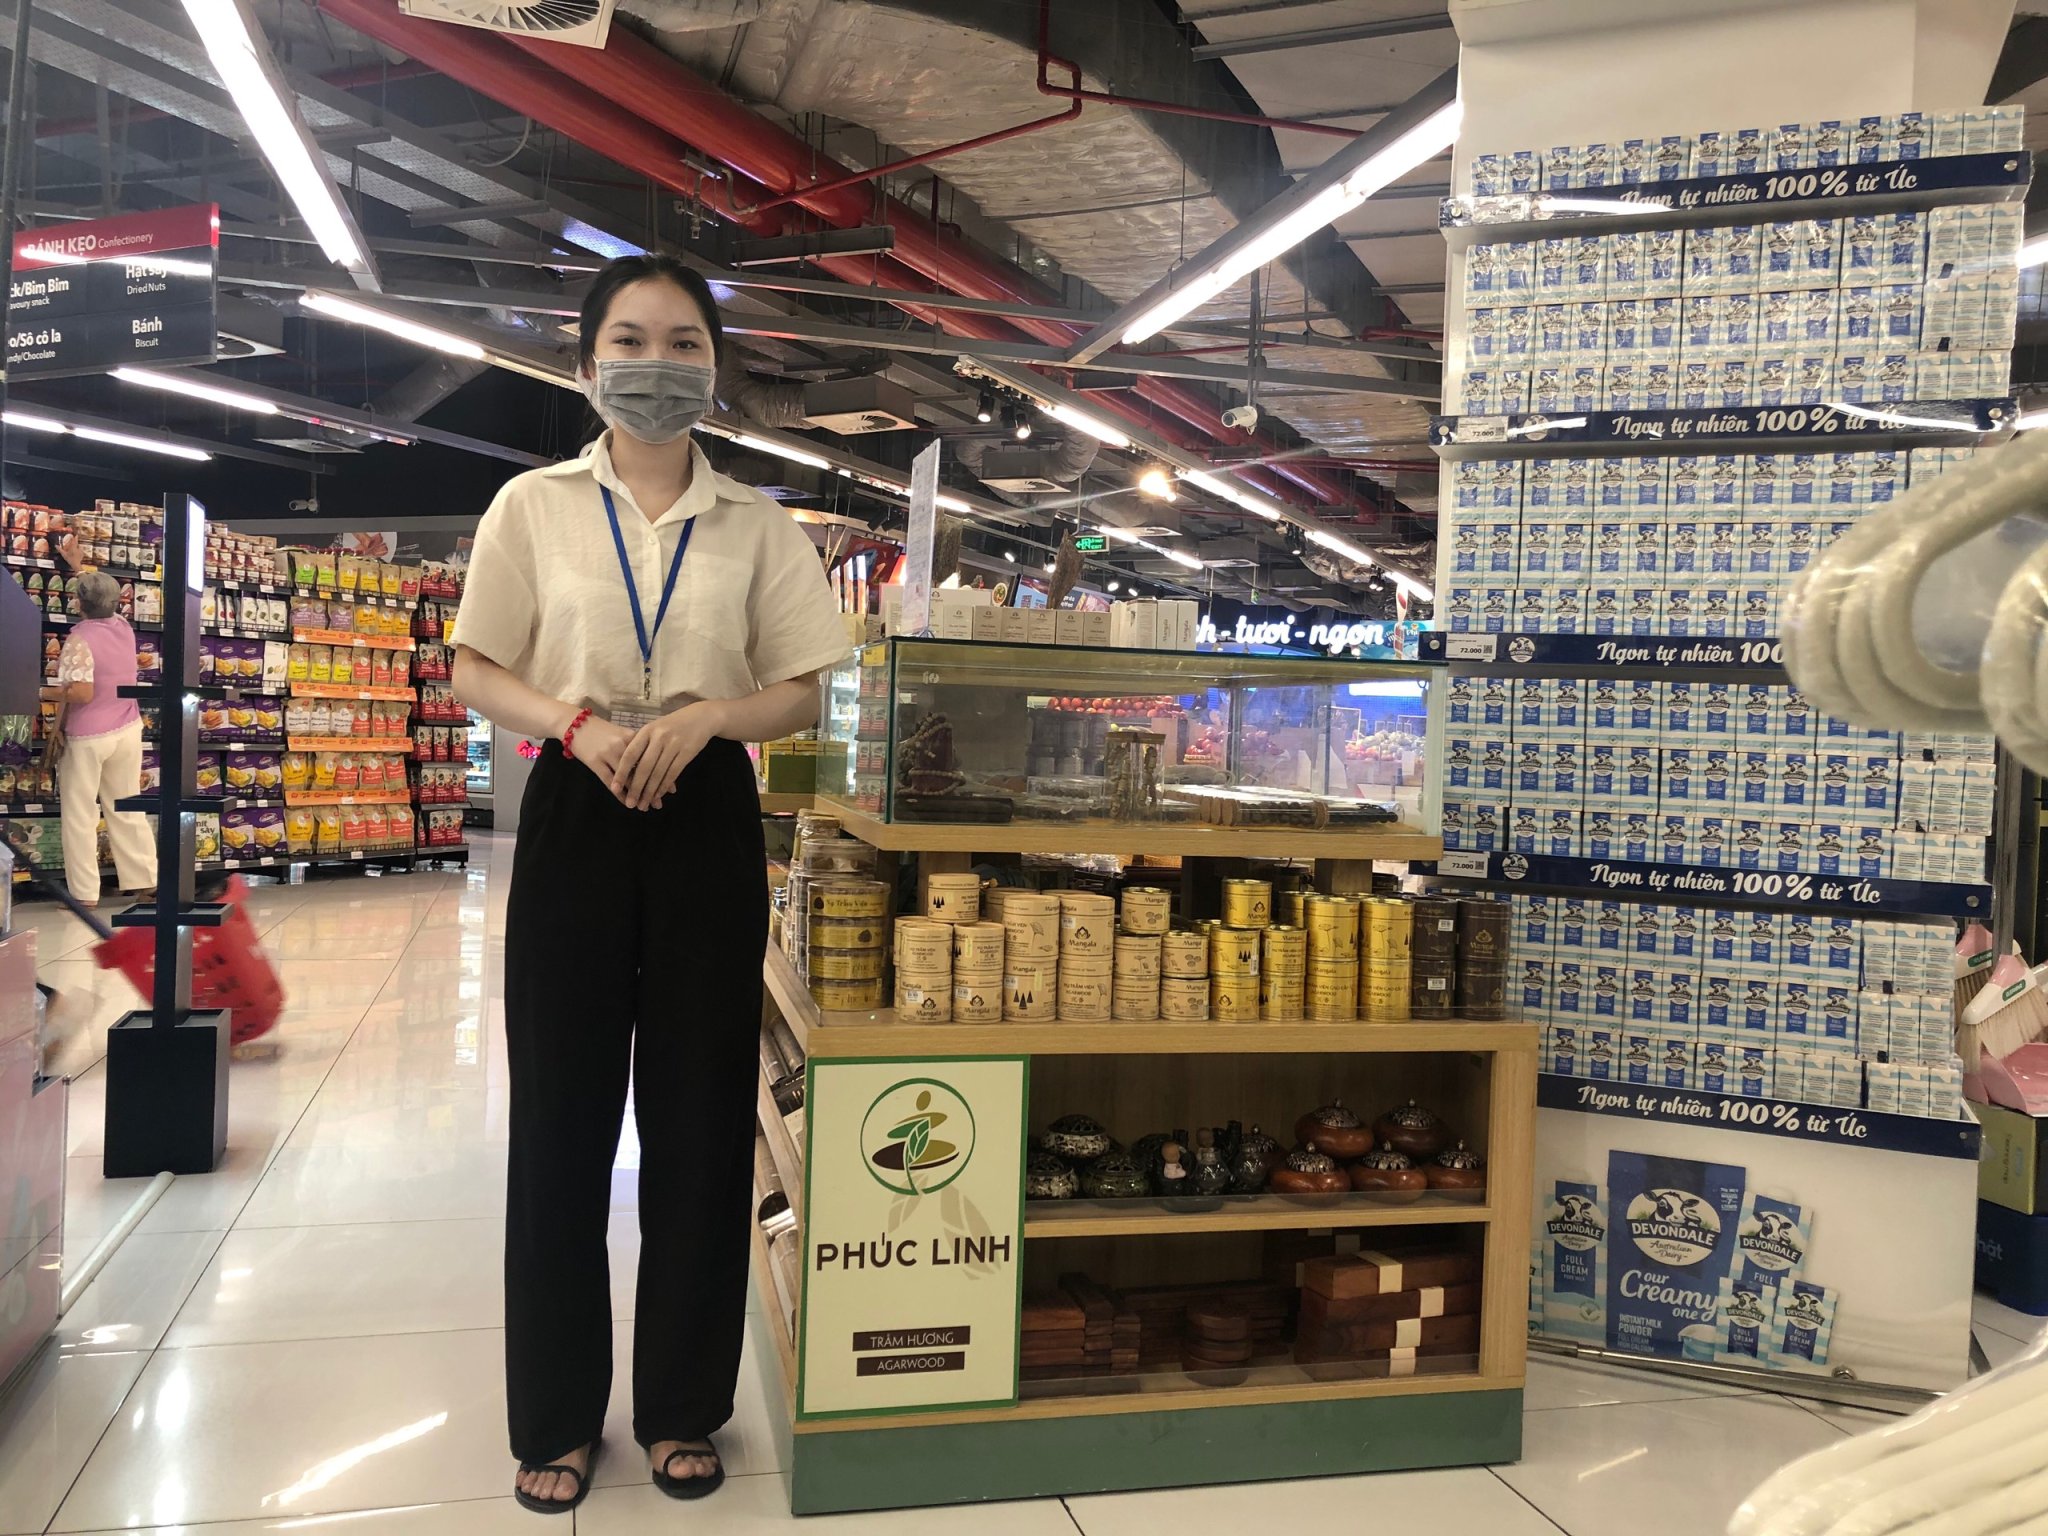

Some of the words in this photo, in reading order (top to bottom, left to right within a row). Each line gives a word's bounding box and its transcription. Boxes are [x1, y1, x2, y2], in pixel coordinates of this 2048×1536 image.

[1680, 189, 1701, 210] tự
[1705, 183, 1759, 205] nhiên
[1766, 170, 1849, 200] 100%
[1856, 174, 1880, 193] từ
[1885, 164, 1918, 190] Úc
[68, 235, 97, 256] KẸO
[98, 233, 153, 249] Confectionery
[48, 277, 69, 293] Bim
[127, 283, 147, 295] Dried
[149, 282, 166, 292] Nuts
[132, 316, 163, 334] Bánh
[36, 330, 49, 345] cô
[51, 328, 61, 343] la
[135, 337, 159, 348] Biscuit
[1611, 415, 1665, 440] Ngon
[1671, 415, 1692, 439] tự
[1697, 413, 1750, 434] nhiên
[1755, 407, 1839, 433] 100%
[1236, 615, 1296, 645] tươi
[1309, 624, 1384, 654] ngon
[1596, 642, 1651, 666] Ngon
[1656, 643, 1677, 667] tự
[1680, 641, 1734, 663] nhiên
[1452, 862, 1474, 870] 72.000
[1590, 863, 1643, 889] Ngon
[1648, 872, 1669, 892] tự
[1673, 871, 1727, 892] nhiên
[1732, 871, 1813, 901] 100%
[1820, 883, 1843, 901] từ
[1848, 877, 1881, 904] Úc
[1577, 1085, 1632, 1111] Ngon
[1635, 1093, 1656, 1117] tự
[1661, 1091, 1714, 1119] nhiên
[1719, 1099, 1800, 1132] 100%
[1806, 1112, 1830, 1134] từ
[1835, 1112, 1868, 1139] Úc
[1549, 1222, 1602, 1239] DEVONDALE
[1631, 1222, 1716, 1247] DEVONDALE
[816, 1232, 918, 1271] PHÚC
[931, 1235, 1011, 1265] LINH
[1649, 1240, 1692, 1253] Australian
[1742, 1237, 1799, 1261] DEVONDALE
[1565, 1254, 1584, 1266] FULL
[1560, 1264, 1589, 1276] CREAM
[1643, 1271, 1670, 1285] our
[1753, 1272, 1774, 1285] FULL
[1619, 1269, 1719, 1322] Creamy
[1672, 1307, 1698, 1320] one
[1728, 1308, 1764, 1322] DEVONDALE
[1786, 1309, 1823, 1323] DEVONDALE
[1618, 1323, 1652, 1337] POWDER
[1645, 1317, 1662, 1329] MILK
[906, 1329, 954, 1346] HƯƠNG
[877, 1356, 945, 1371] AGARWOOD
